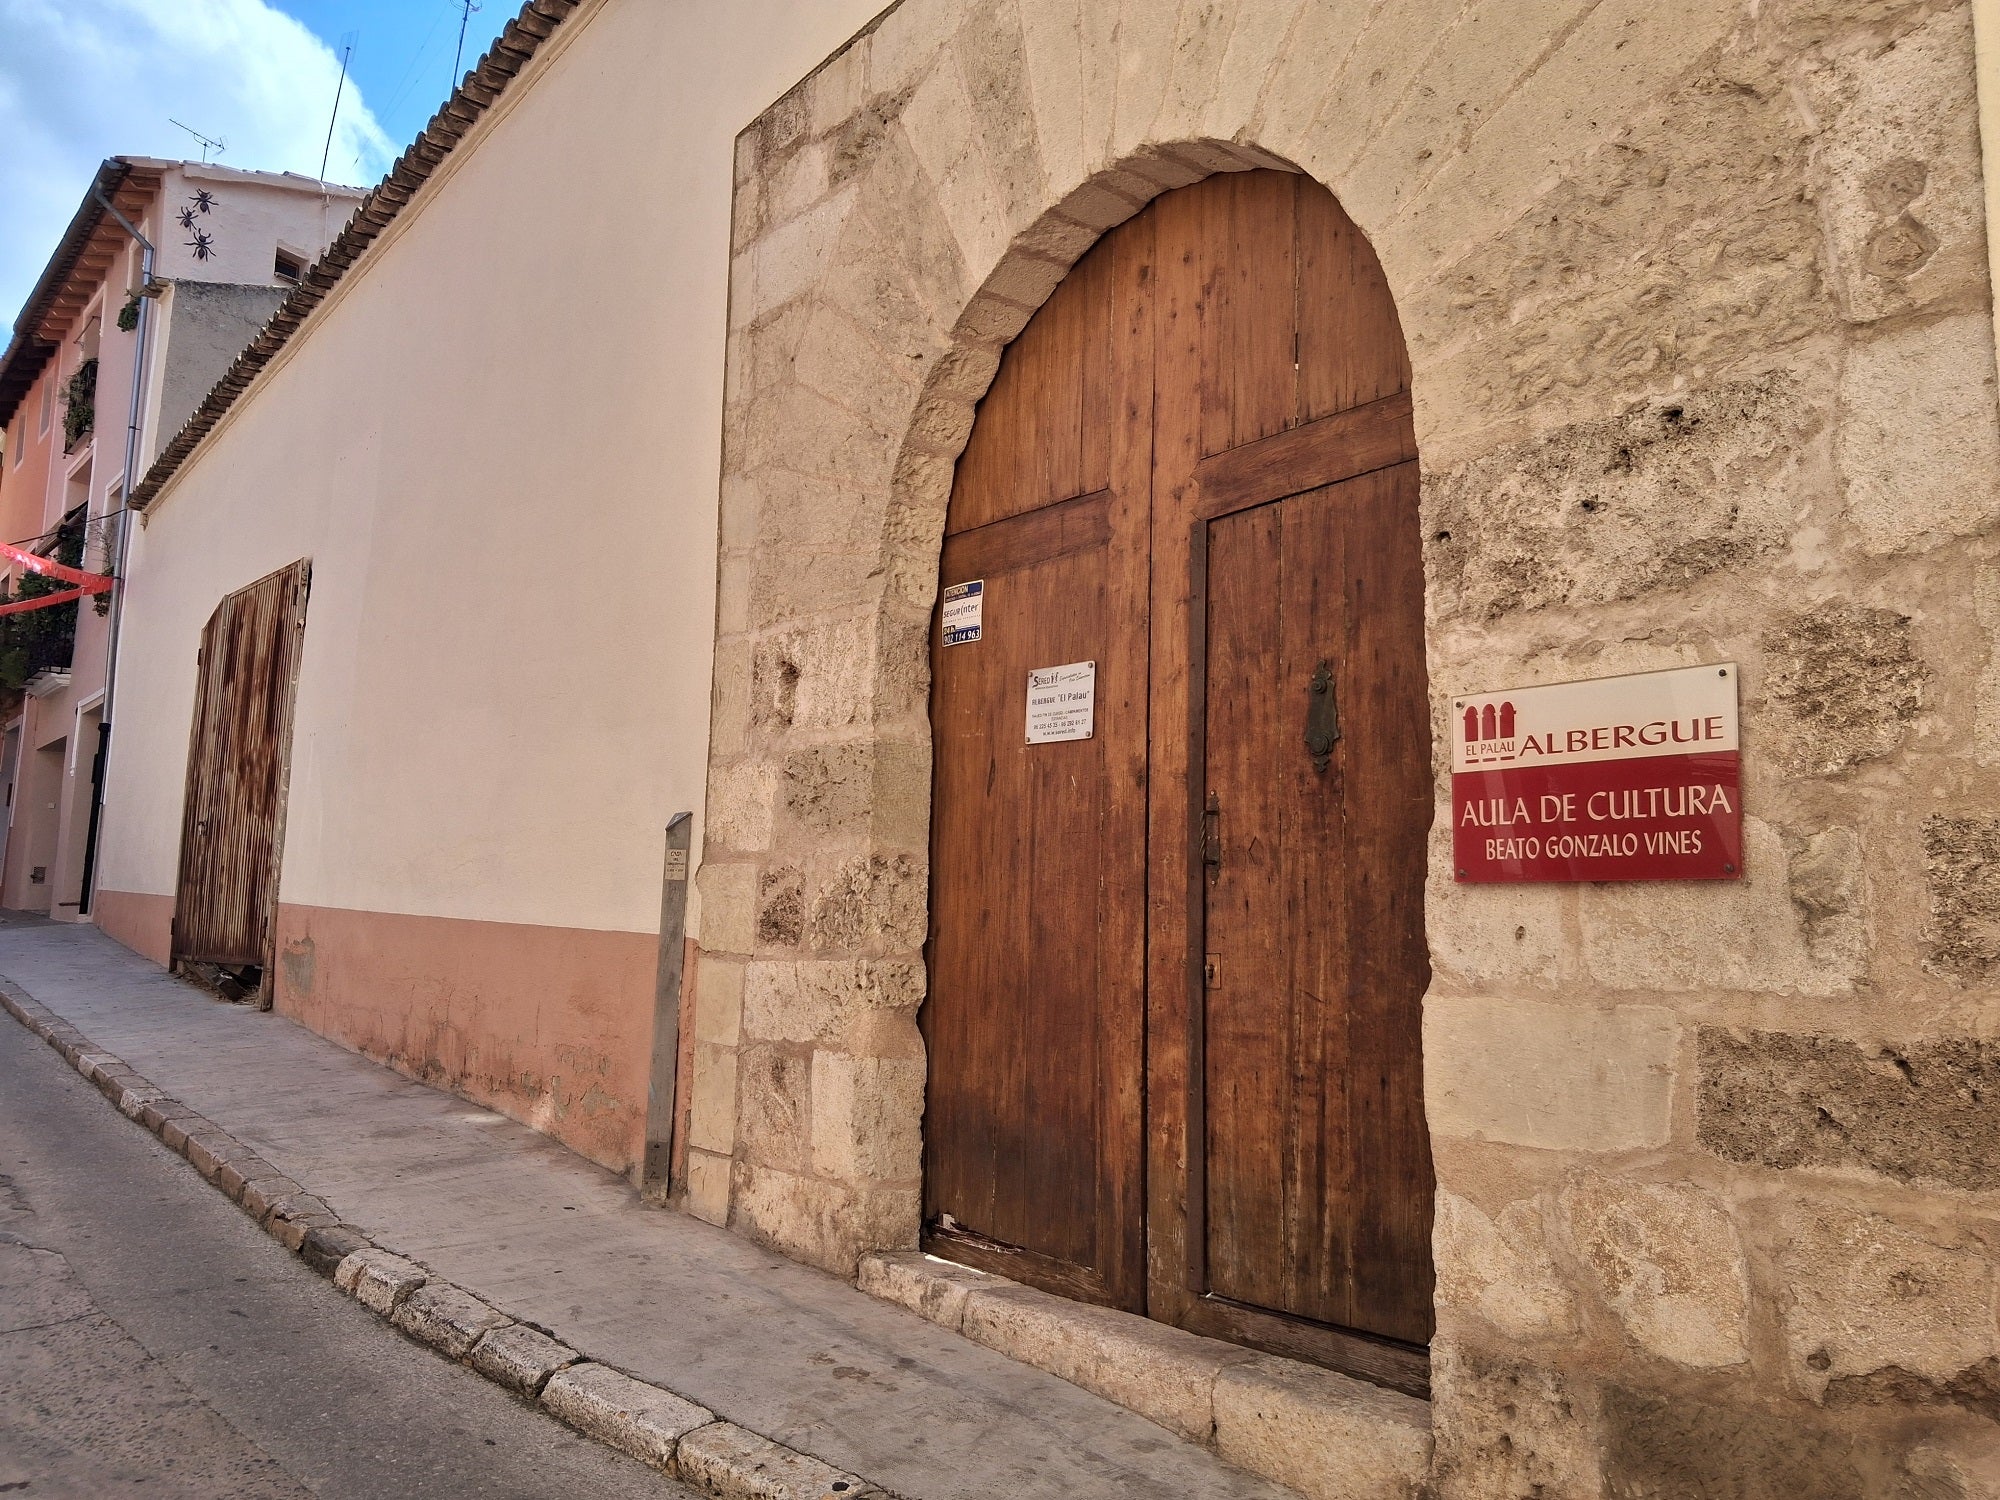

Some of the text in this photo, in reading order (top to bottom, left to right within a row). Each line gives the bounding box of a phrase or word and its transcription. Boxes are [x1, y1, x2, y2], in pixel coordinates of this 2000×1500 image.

[955, 632, 966, 642] 114
[967, 629, 980, 639] 963
[1465, 740, 1515, 756] EL PALAU
[1519, 715, 1724, 757] ALBERGUE
[1460, 783, 1733, 828] AULA DE CULTURA
[1485, 829, 1702, 861] BEATO GONZALO VINES
